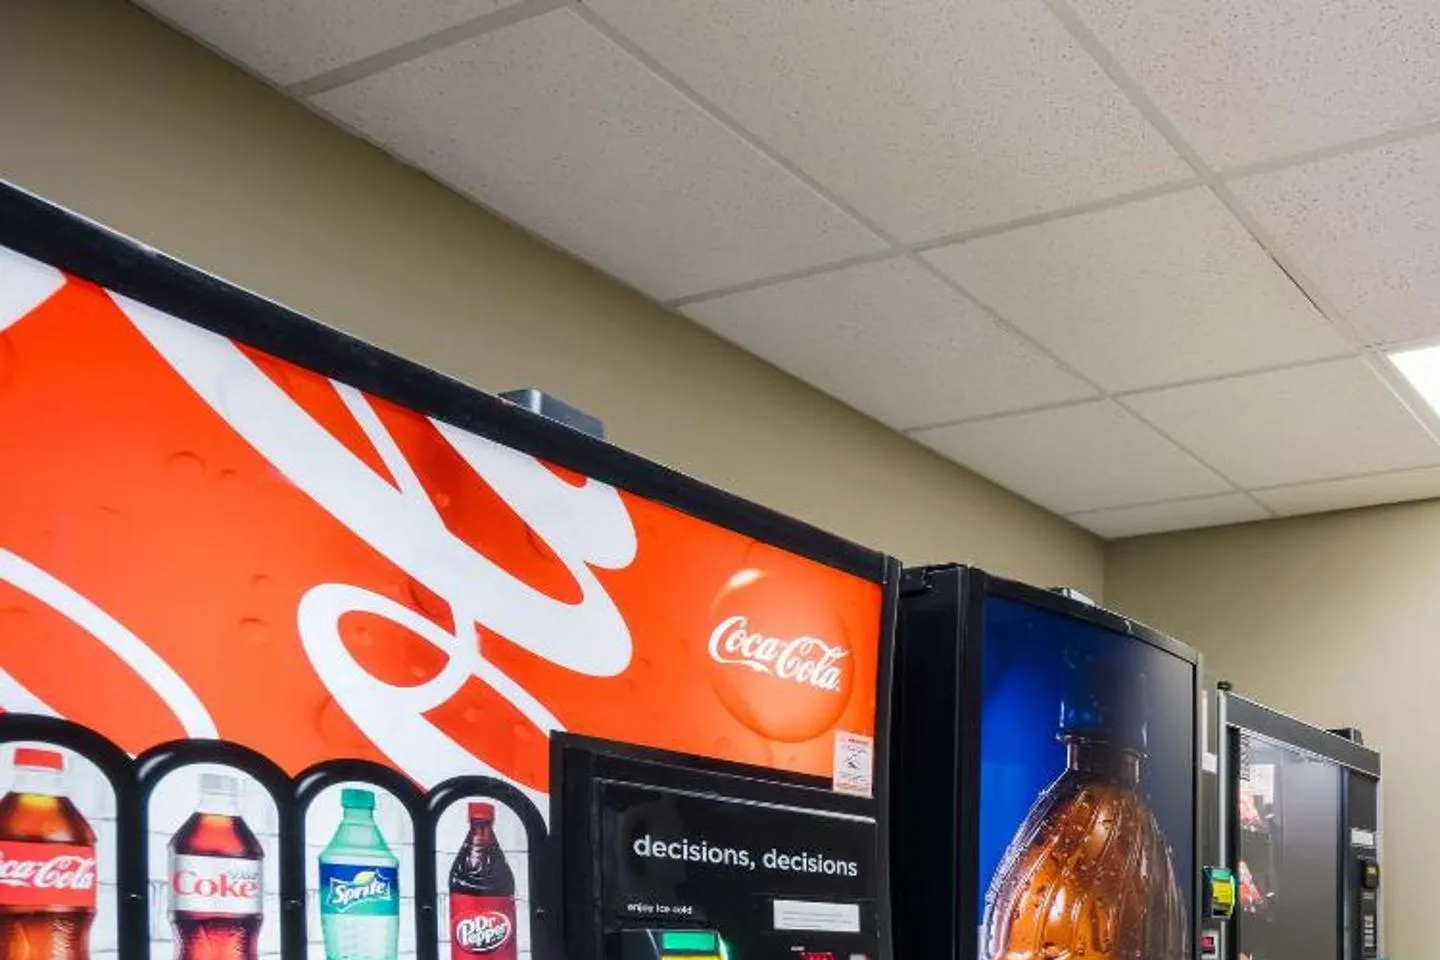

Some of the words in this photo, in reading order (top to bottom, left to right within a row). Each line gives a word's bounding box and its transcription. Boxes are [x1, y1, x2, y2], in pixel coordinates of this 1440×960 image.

[708, 615, 848, 692] Coca-Cola
[0, 851, 94, 890] ca-Cola
[633, 834, 756, 870] decisions,
[762, 848, 859, 877] decisions
[172, 869, 260, 899] Coke
[332, 880, 387, 905] Sprite
[460, 919, 507, 948] Pepper
[474, 915, 497, 931] Dr
